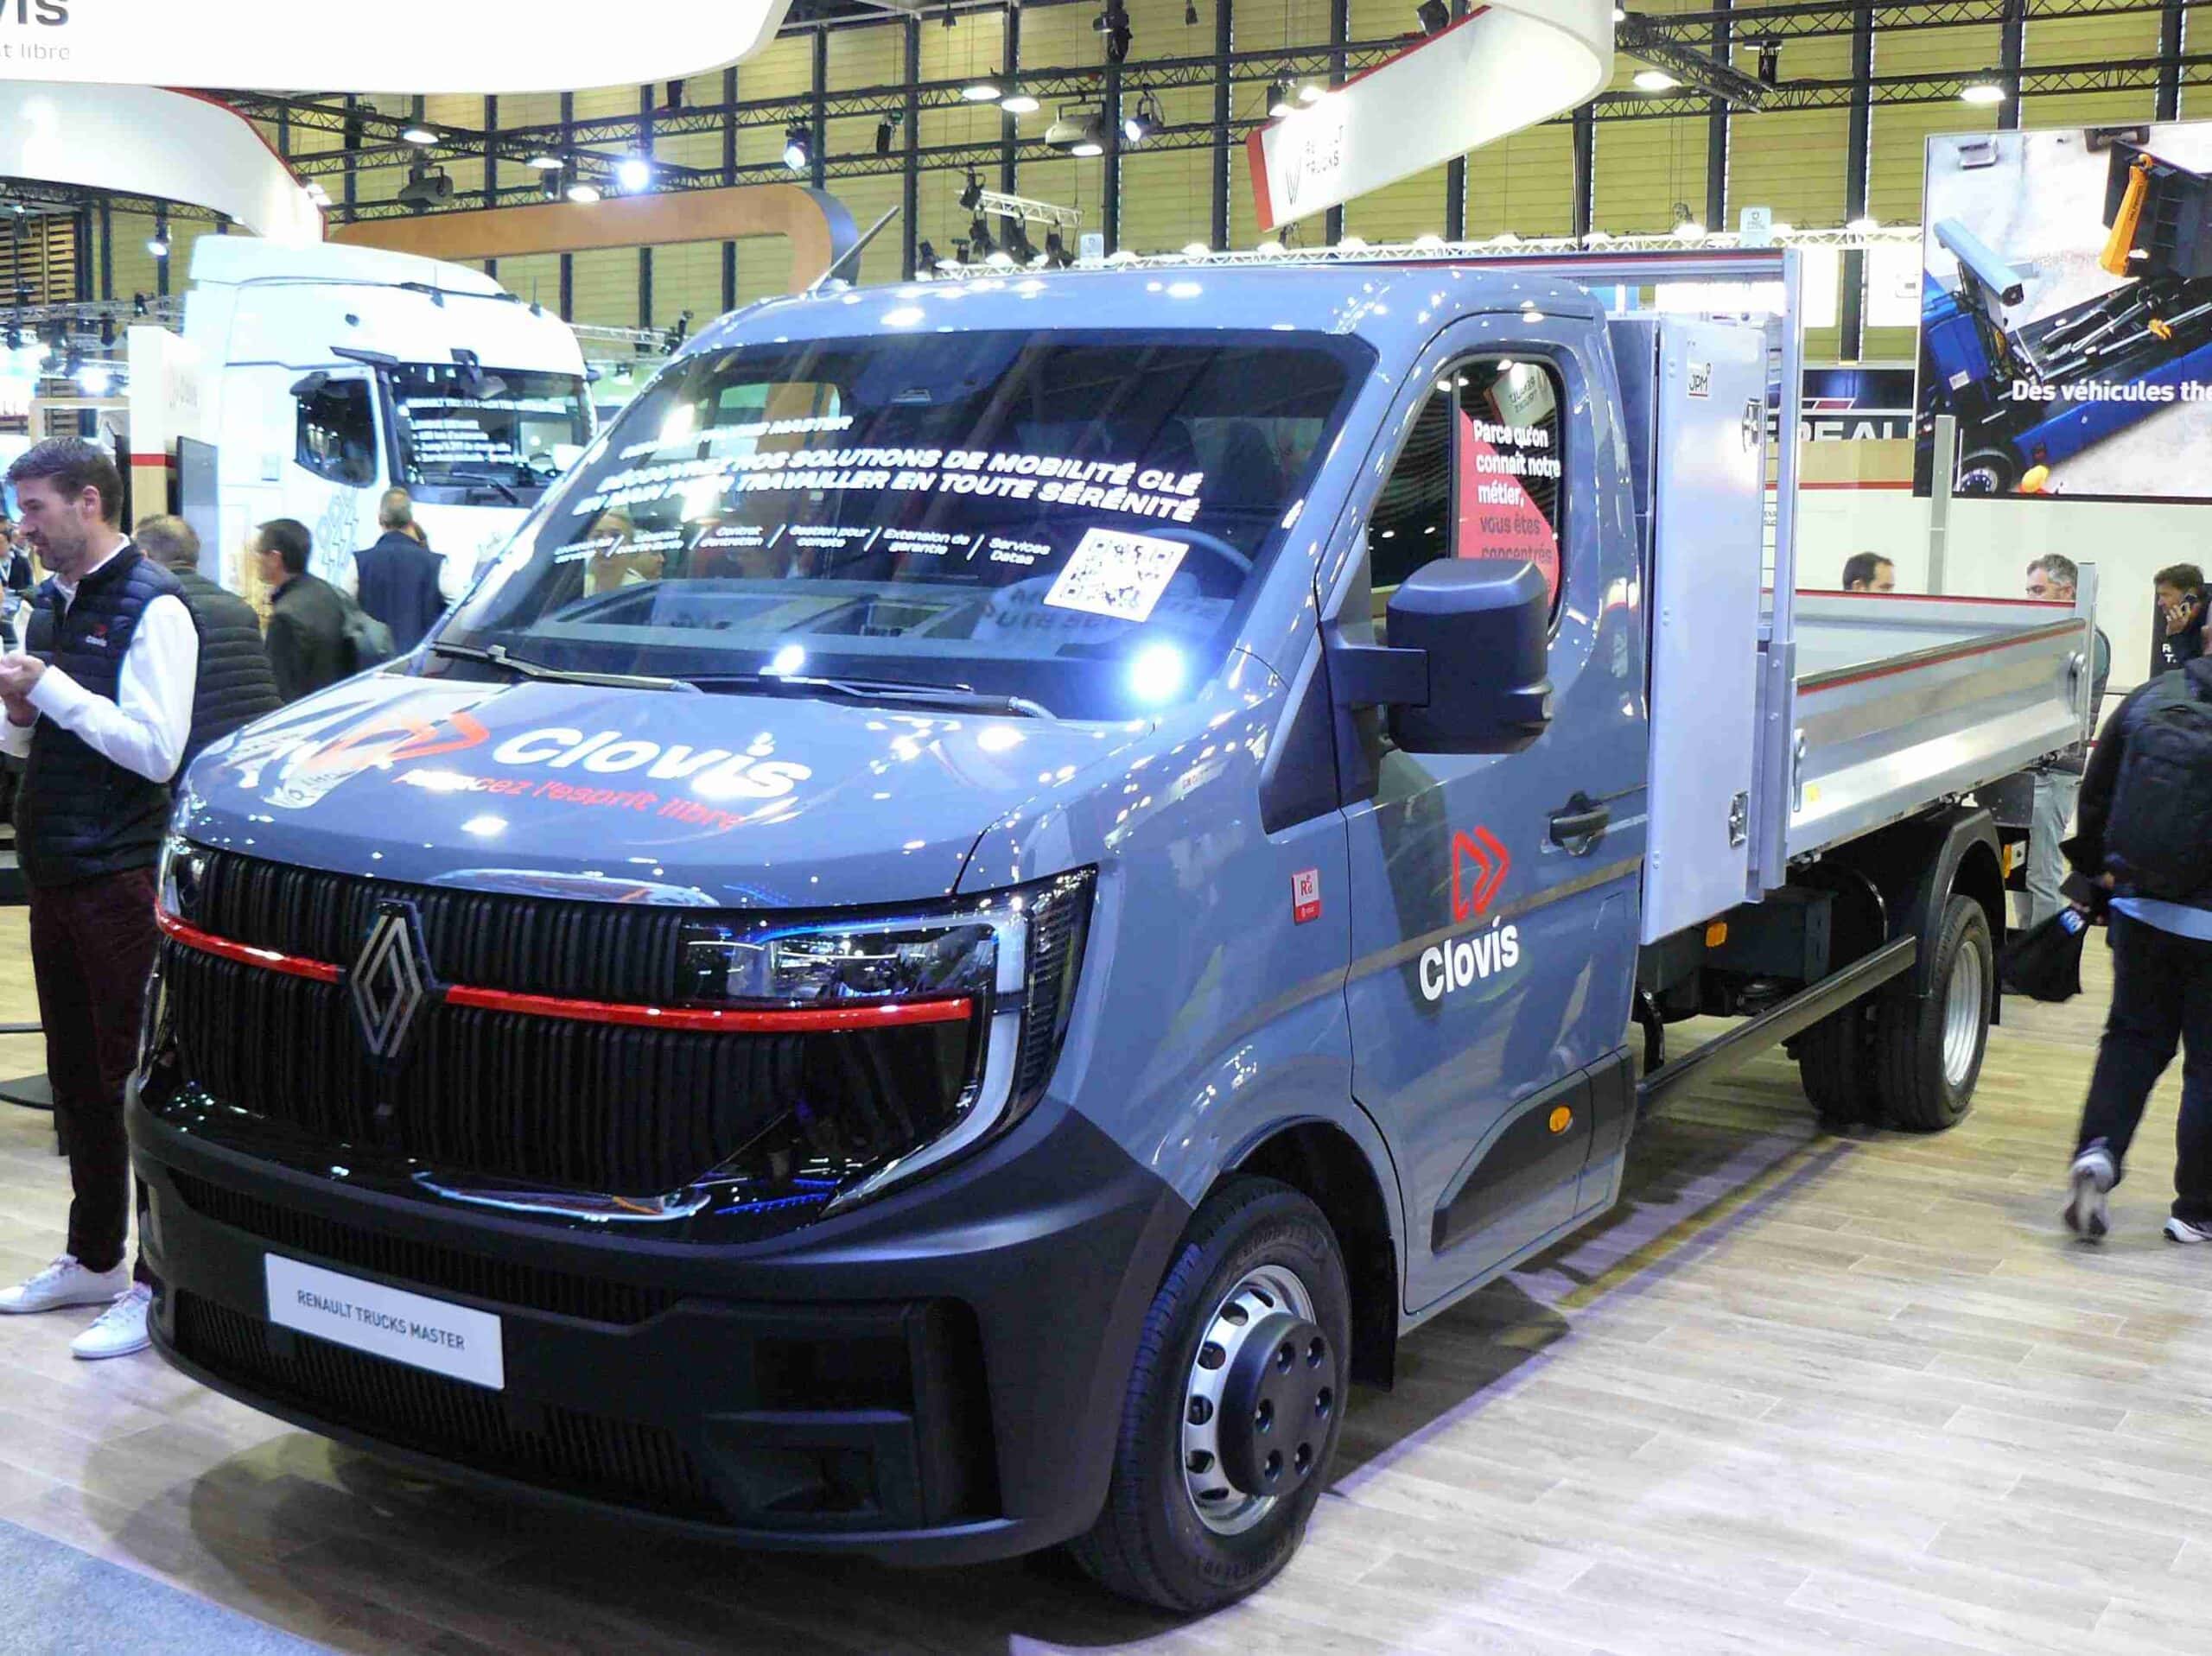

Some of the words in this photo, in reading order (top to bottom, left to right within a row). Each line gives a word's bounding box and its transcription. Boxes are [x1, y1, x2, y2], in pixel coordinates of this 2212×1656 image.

[0, 0, 69, 26] is
[21, 43, 70, 60] libre
[1689, 373, 1708, 392] JPM
[2012, 379, 2056, 402] Des
[2060, 378, 2175, 402] véhicules
[1472, 420, 1512, 444] Parce
[788, 447, 943, 470] SOLUTIONS
[942, 450, 988, 470] DE
[988, 453, 1137, 485] MOBILITÉ
[1137, 469, 1204, 497] CLÉ
[1528, 457, 1561, 479] notre
[736, 470, 891, 492] TRAVAILLER
[890, 472, 938, 492] EN
[938, 472, 1038, 499] TOUTE
[1037, 480, 1200, 523] SÉRÉNITÉ
[1478, 479, 1524, 508] métier,
[1479, 515, 1512, 534] vous
[1514, 513, 1541, 535] êtes
[493, 728, 812, 797] Clovis
[532, 779, 658, 811] l'esprit
[1419, 916, 1520, 1001] Clovis
[297, 1290, 353, 1319] RENAULT
[354, 1306, 407, 1335] TRUCKS
[410, 1322, 466, 1351] MASTER
